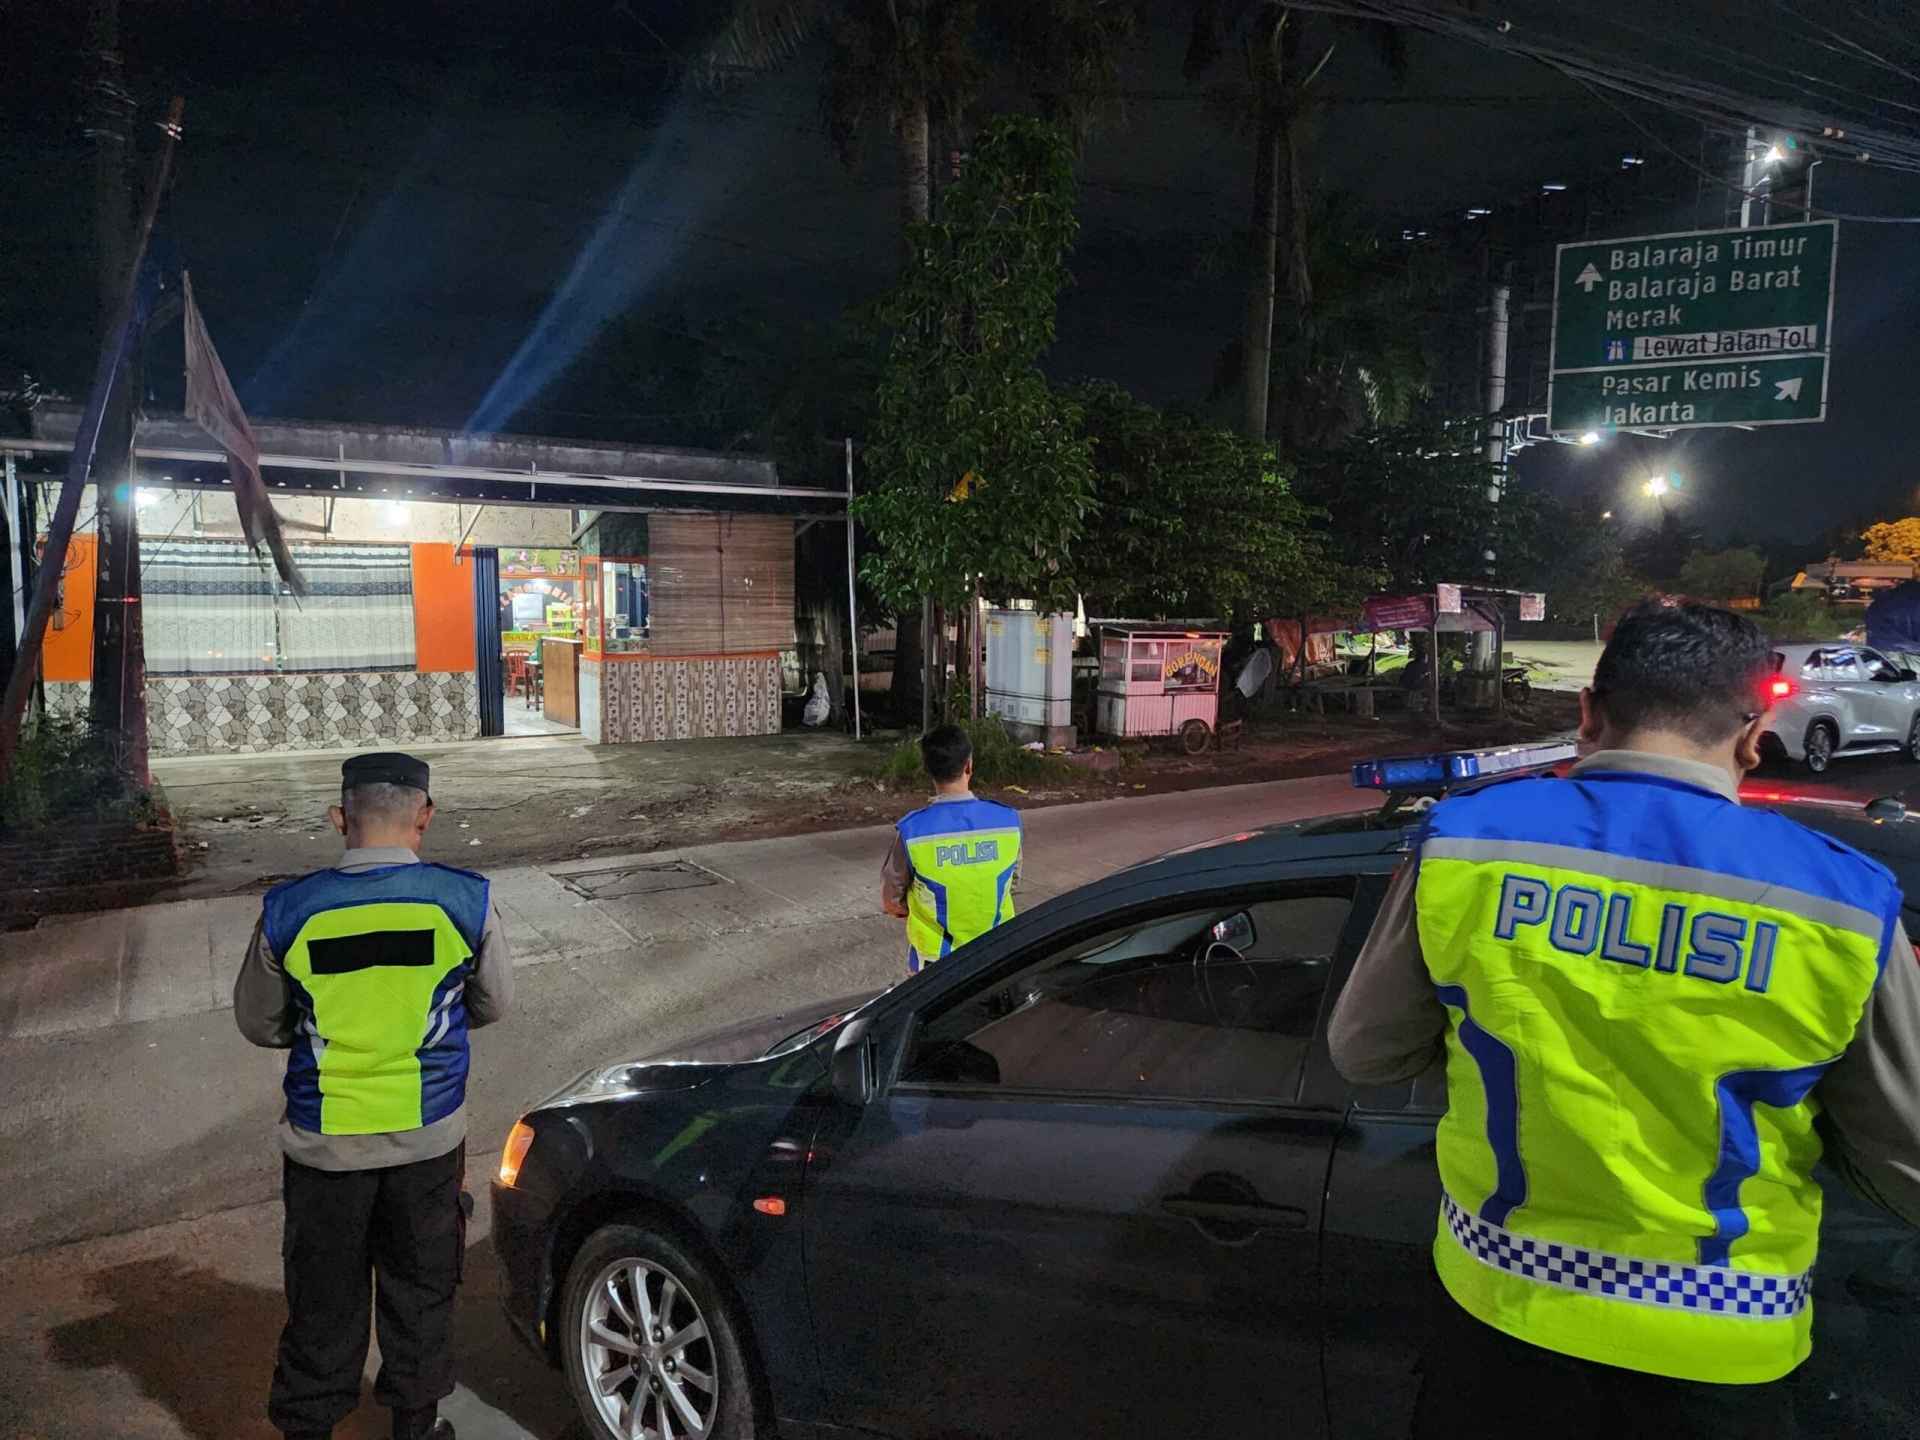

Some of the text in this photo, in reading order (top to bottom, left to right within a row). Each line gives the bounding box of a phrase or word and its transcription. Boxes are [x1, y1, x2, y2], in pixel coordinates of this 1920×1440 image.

[1610, 236, 1808, 270] Balaraja Timur
[1608, 265, 1802, 301] Balaraja Barat
[1606, 304, 1682, 330] Merak
[1643, 327, 1810, 358] Lewat Jalan Tol
[1602, 365, 1762, 397] Pasar Kemis
[1602, 401, 1695, 425] Jakarta
[935, 840, 999, 868] POLISI
[1493, 873, 1779, 994] POLISI
